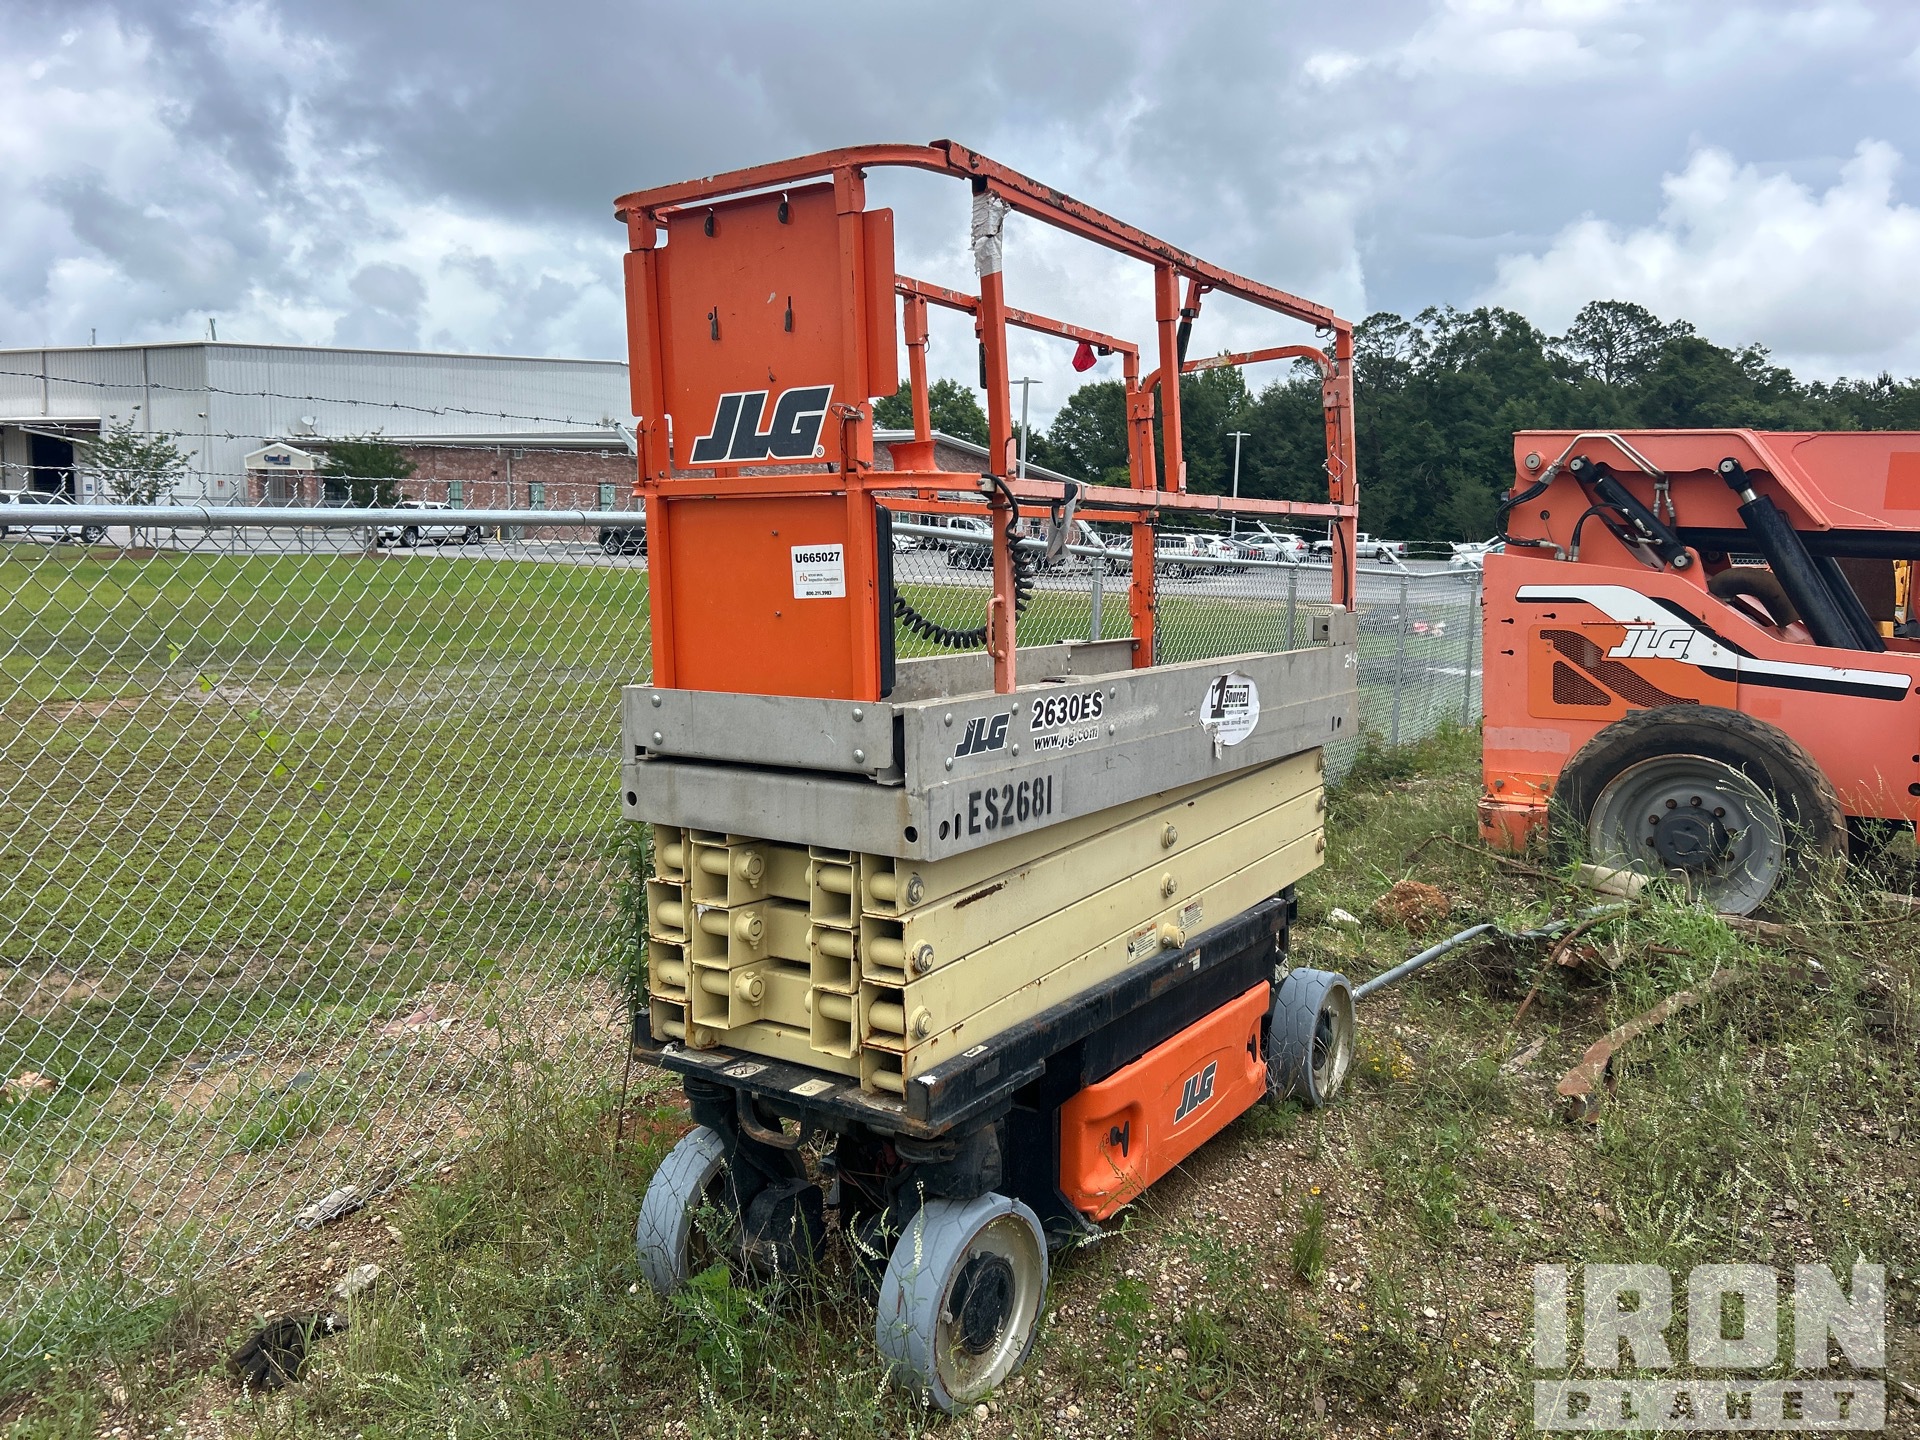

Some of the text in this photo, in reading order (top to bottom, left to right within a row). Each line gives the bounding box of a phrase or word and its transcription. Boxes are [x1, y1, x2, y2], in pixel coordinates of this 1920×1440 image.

[690, 385, 834, 464] JLG
[795, 552, 840, 563] U665027
[1606, 629, 1695, 659] JLG
[1031, 691, 1103, 729] 2630ES
[1211, 675, 1247, 718] 1 Source
[954, 712, 1010, 759] JLG
[968, 775, 1052, 835] ES2681
[1173, 1060, 1217, 1125] JLG
